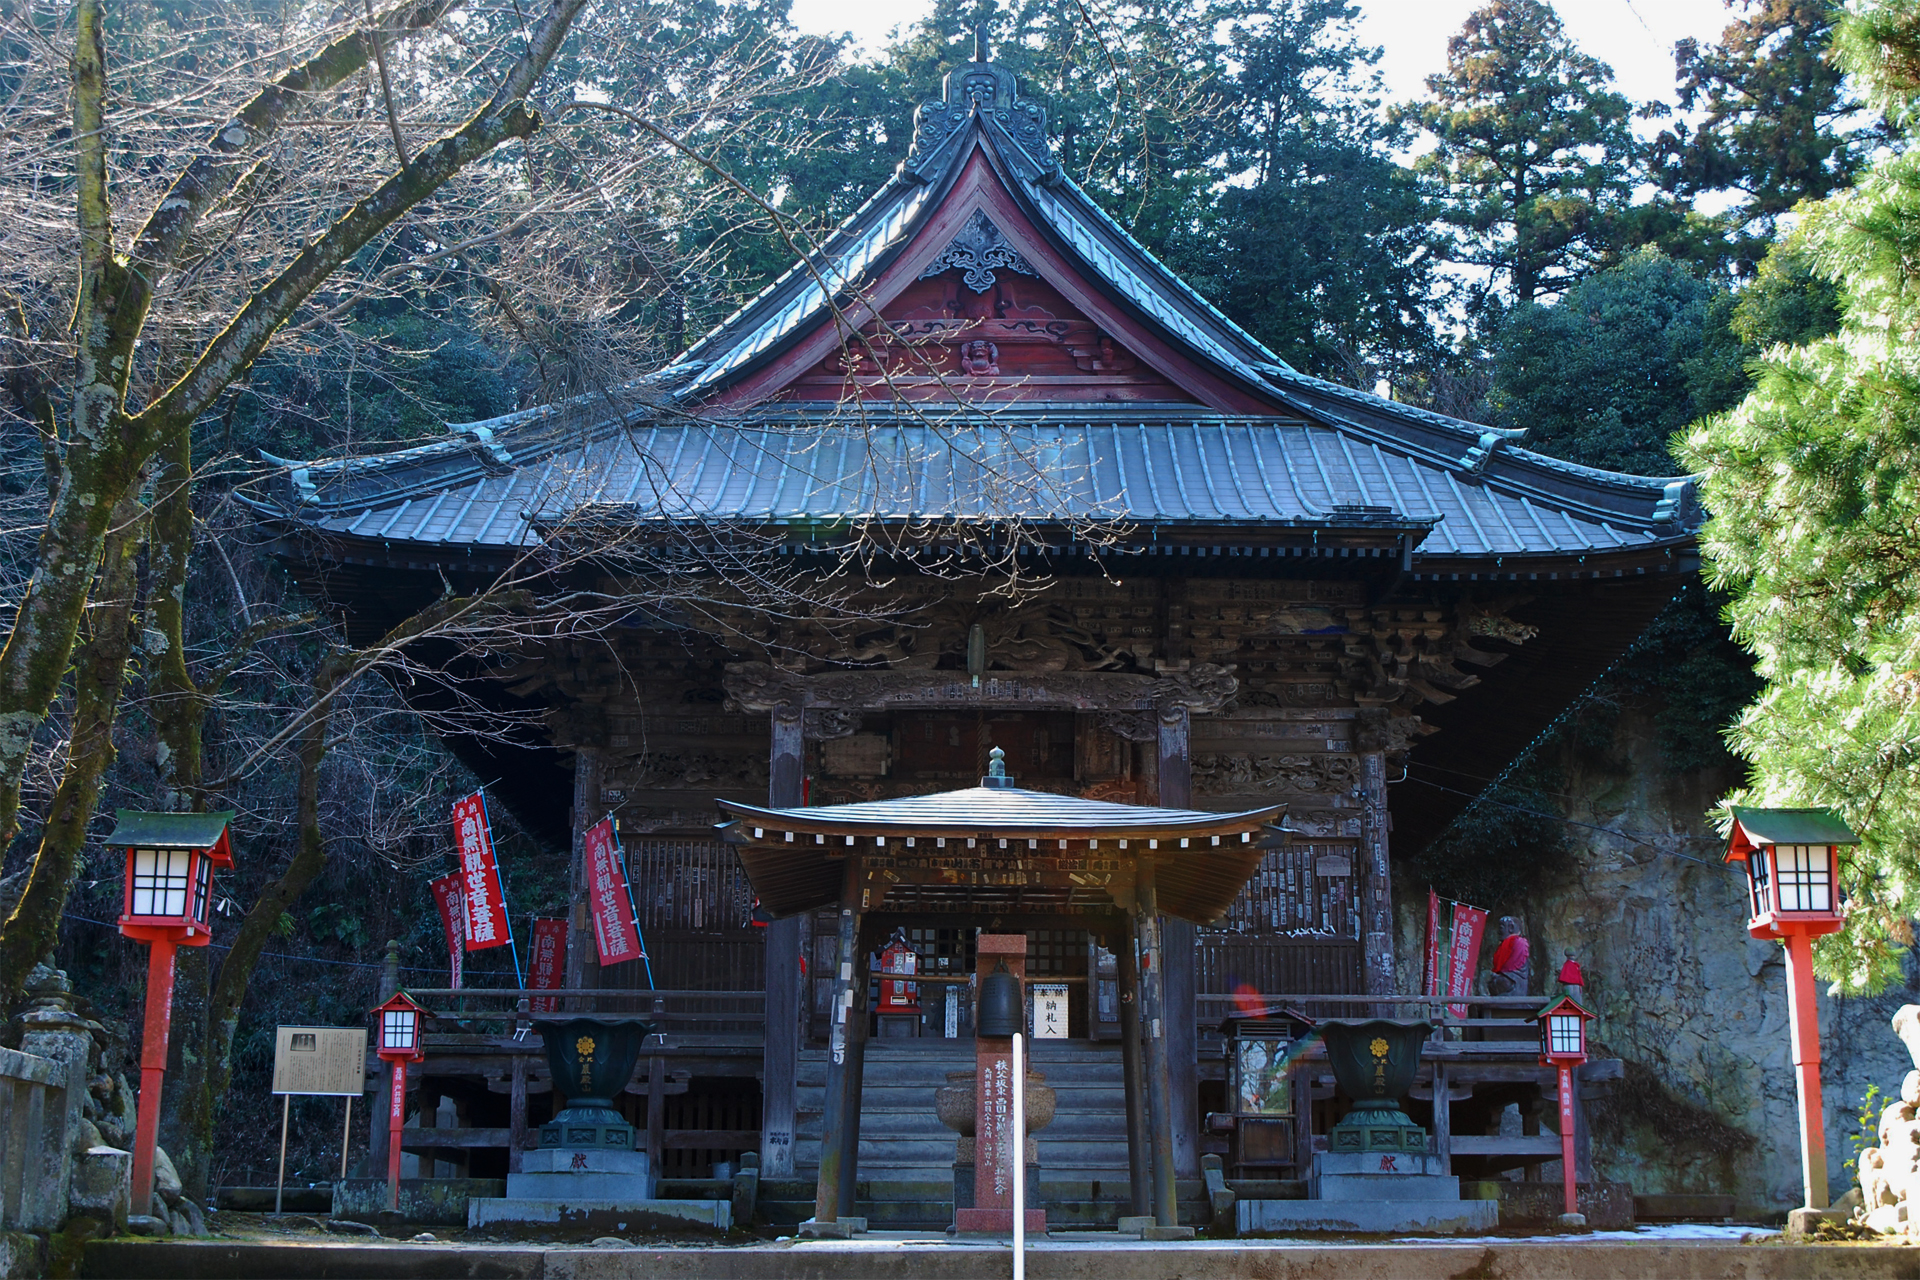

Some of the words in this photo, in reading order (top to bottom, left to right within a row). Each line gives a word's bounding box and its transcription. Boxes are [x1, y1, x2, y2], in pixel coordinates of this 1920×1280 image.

[461, 817, 497, 943] 南無観世音菩薩
[594, 842, 629, 957] 南無観世音菩薩
[895, 955, 904, 994] おみじ
[1045, 1000, 1057, 1034] 納札入
